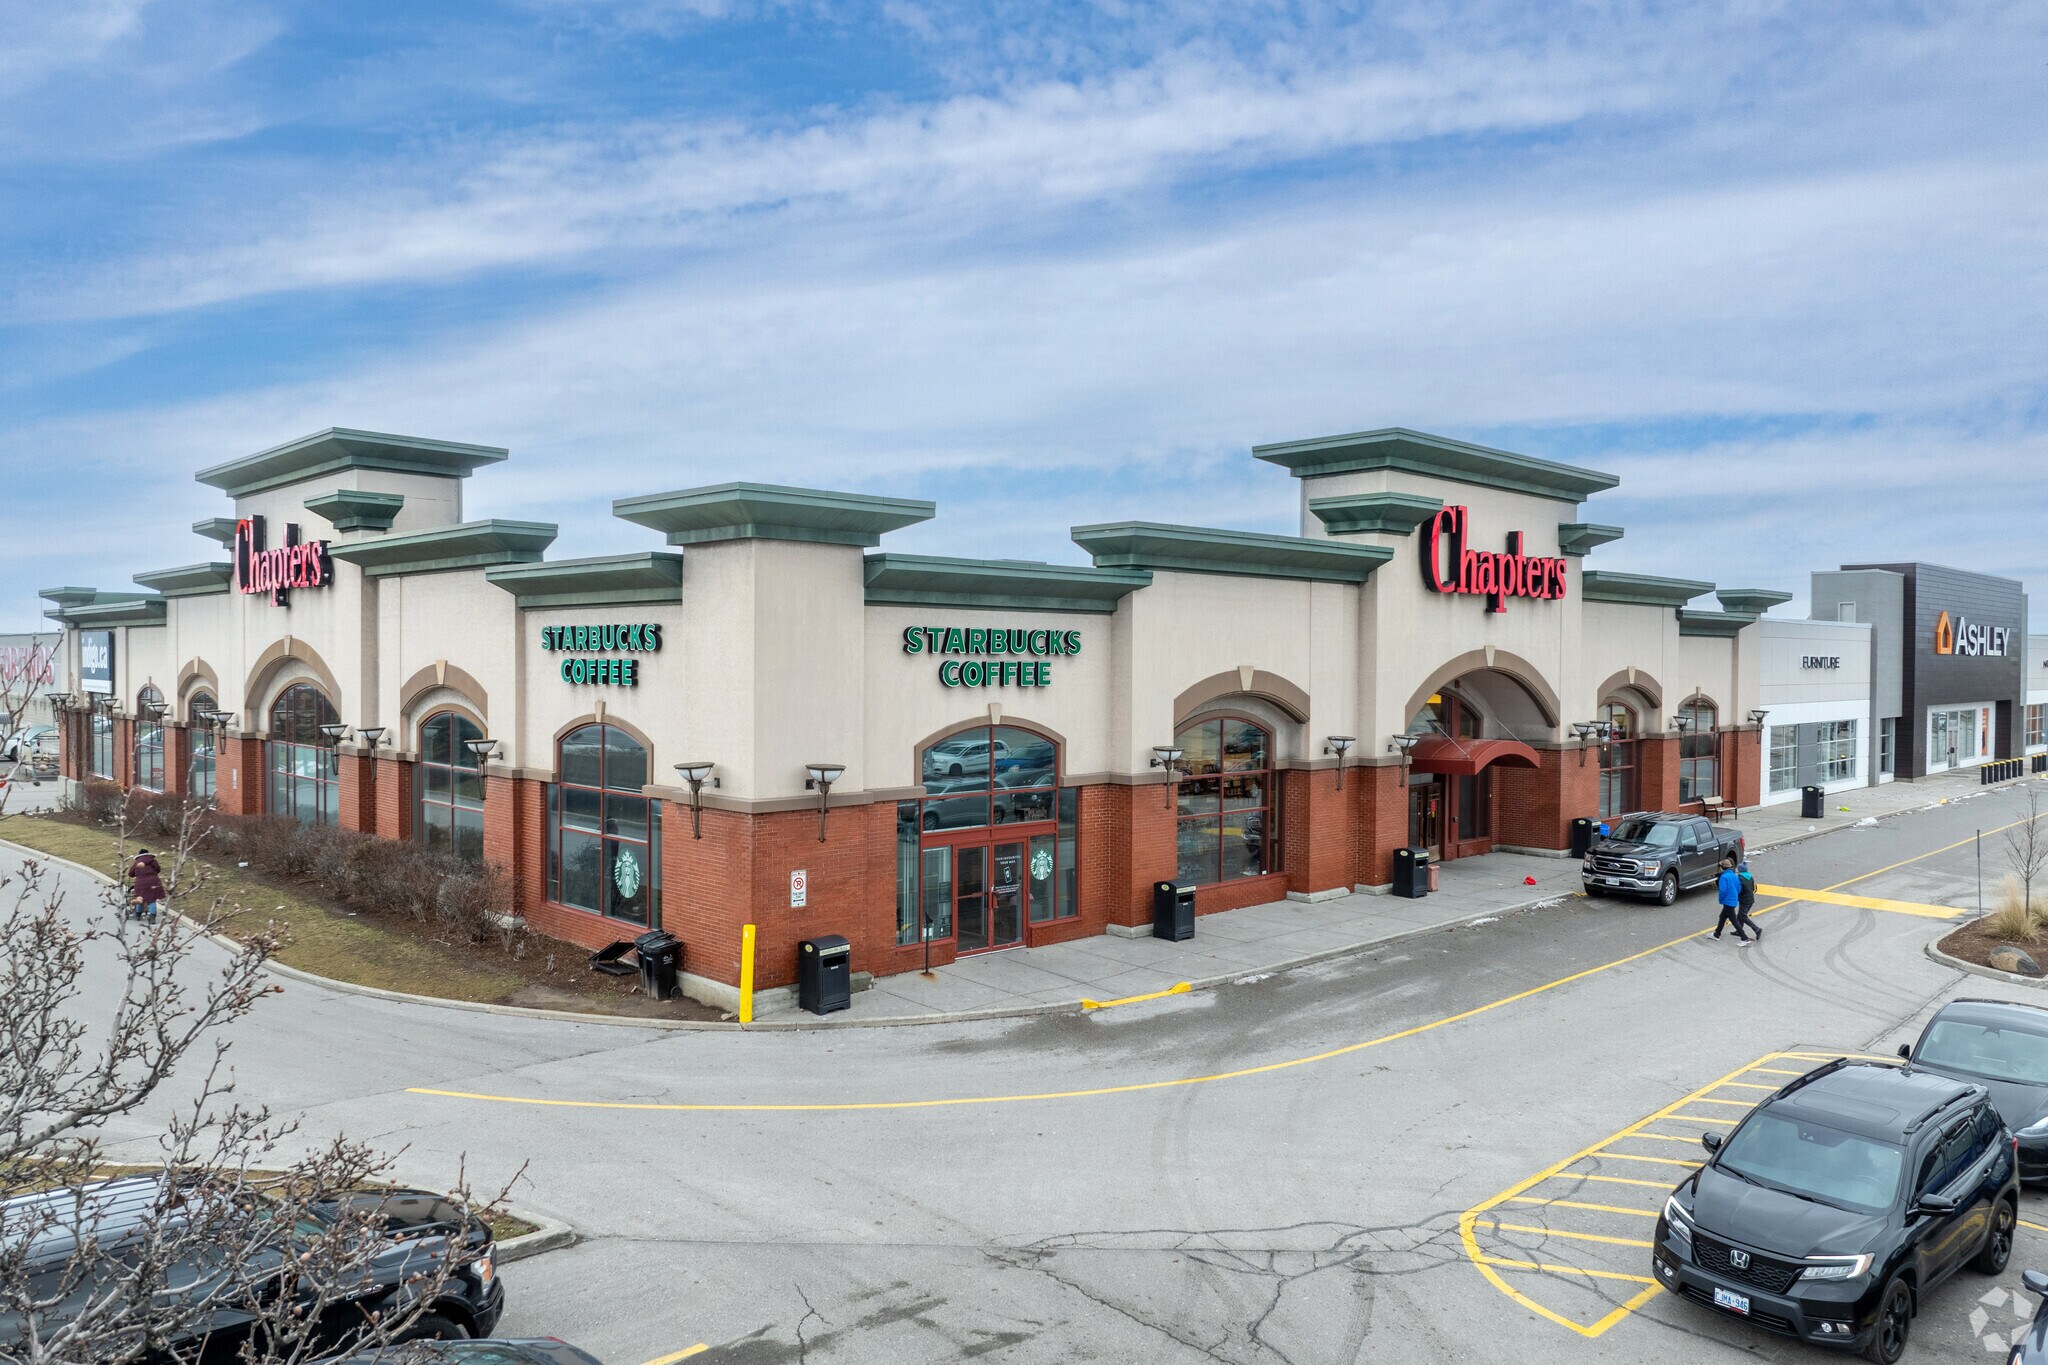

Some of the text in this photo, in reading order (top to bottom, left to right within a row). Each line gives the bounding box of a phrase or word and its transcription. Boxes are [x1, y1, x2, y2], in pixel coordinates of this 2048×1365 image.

[234, 514, 327, 607] Chapters
[1427, 505, 1567, 613] Chapters
[541, 623, 660, 652] STARBUCKS
[904, 626, 1081, 656] STARBUCKS
[1955, 616, 2010, 656] ASHLEY
[0, 647, 55, 685] ORTINOS
[82, 637, 108, 674] indigo.ca
[561, 658, 637, 686] COFFEE
[1801, 655, 1840, 669] FURNITURE
[940, 660, 1052, 688] COFFEE
